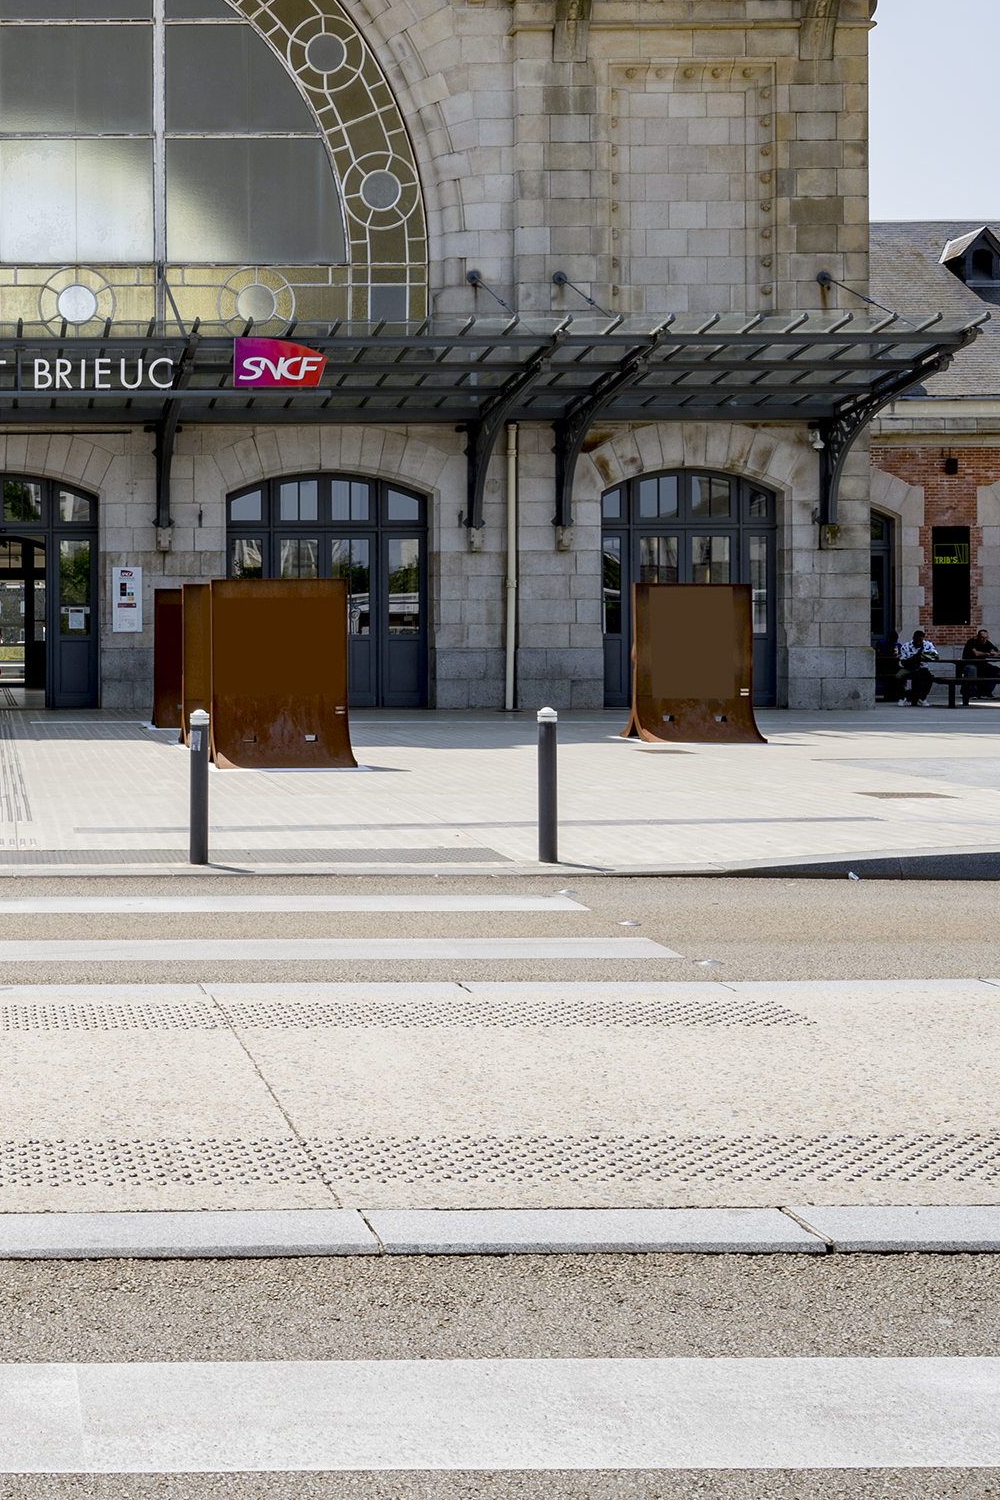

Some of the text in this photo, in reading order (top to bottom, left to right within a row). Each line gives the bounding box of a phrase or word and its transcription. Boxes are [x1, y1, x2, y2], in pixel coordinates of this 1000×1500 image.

[34, 358, 173, 389] BRIEUC
[238, 357, 323, 380] SNCF
[934, 556, 958, 564] TRIB'S
